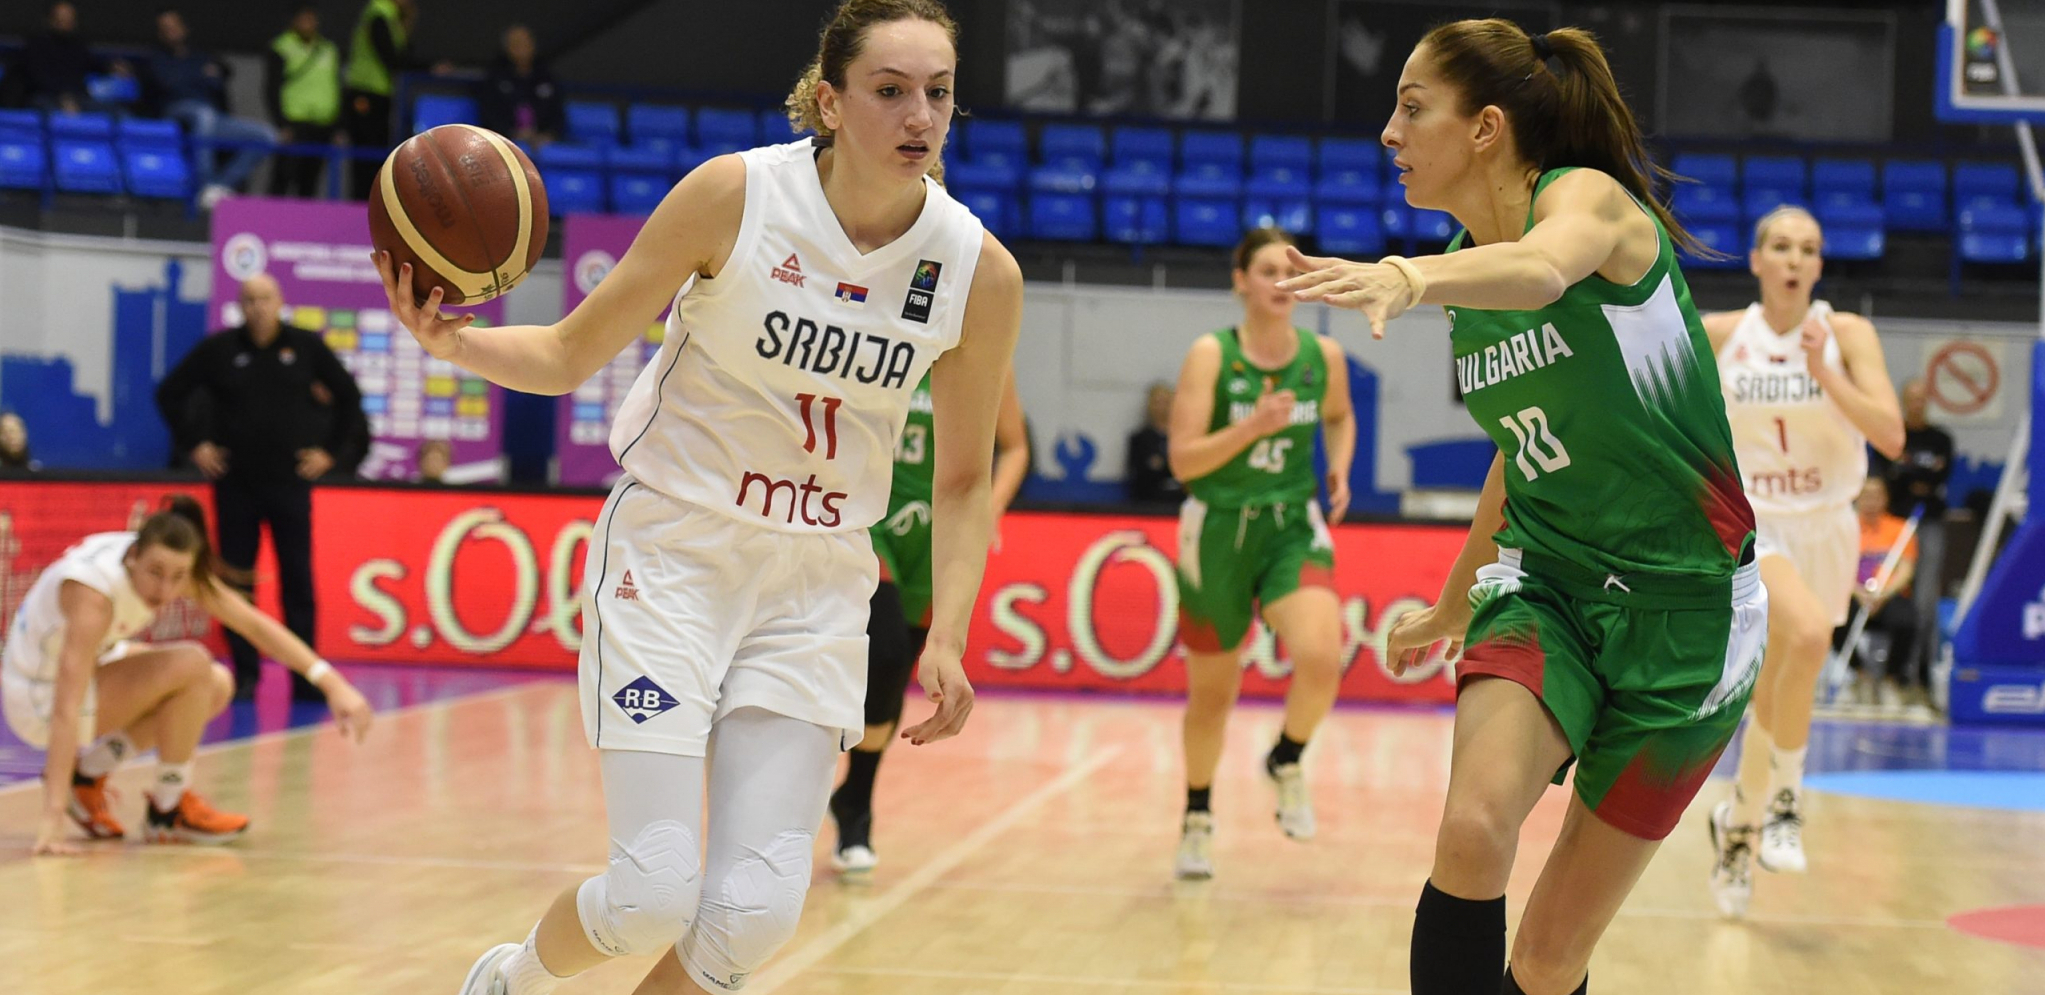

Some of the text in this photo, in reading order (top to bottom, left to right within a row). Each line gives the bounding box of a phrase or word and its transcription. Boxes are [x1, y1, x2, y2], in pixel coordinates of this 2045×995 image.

[770, 266, 807, 288] PEAK
[909, 293, 928, 307] FIBA
[755, 310, 915, 389] SRBIJA
[795, 393, 842, 460] 11
[1499, 406, 1571, 482] 10
[1773, 416, 1787, 453] 1
[1248, 438, 1294, 473] 45
[1752, 467, 1822, 494] mts
[735, 471, 848, 527] mts
[614, 586, 639, 600] PEAK
